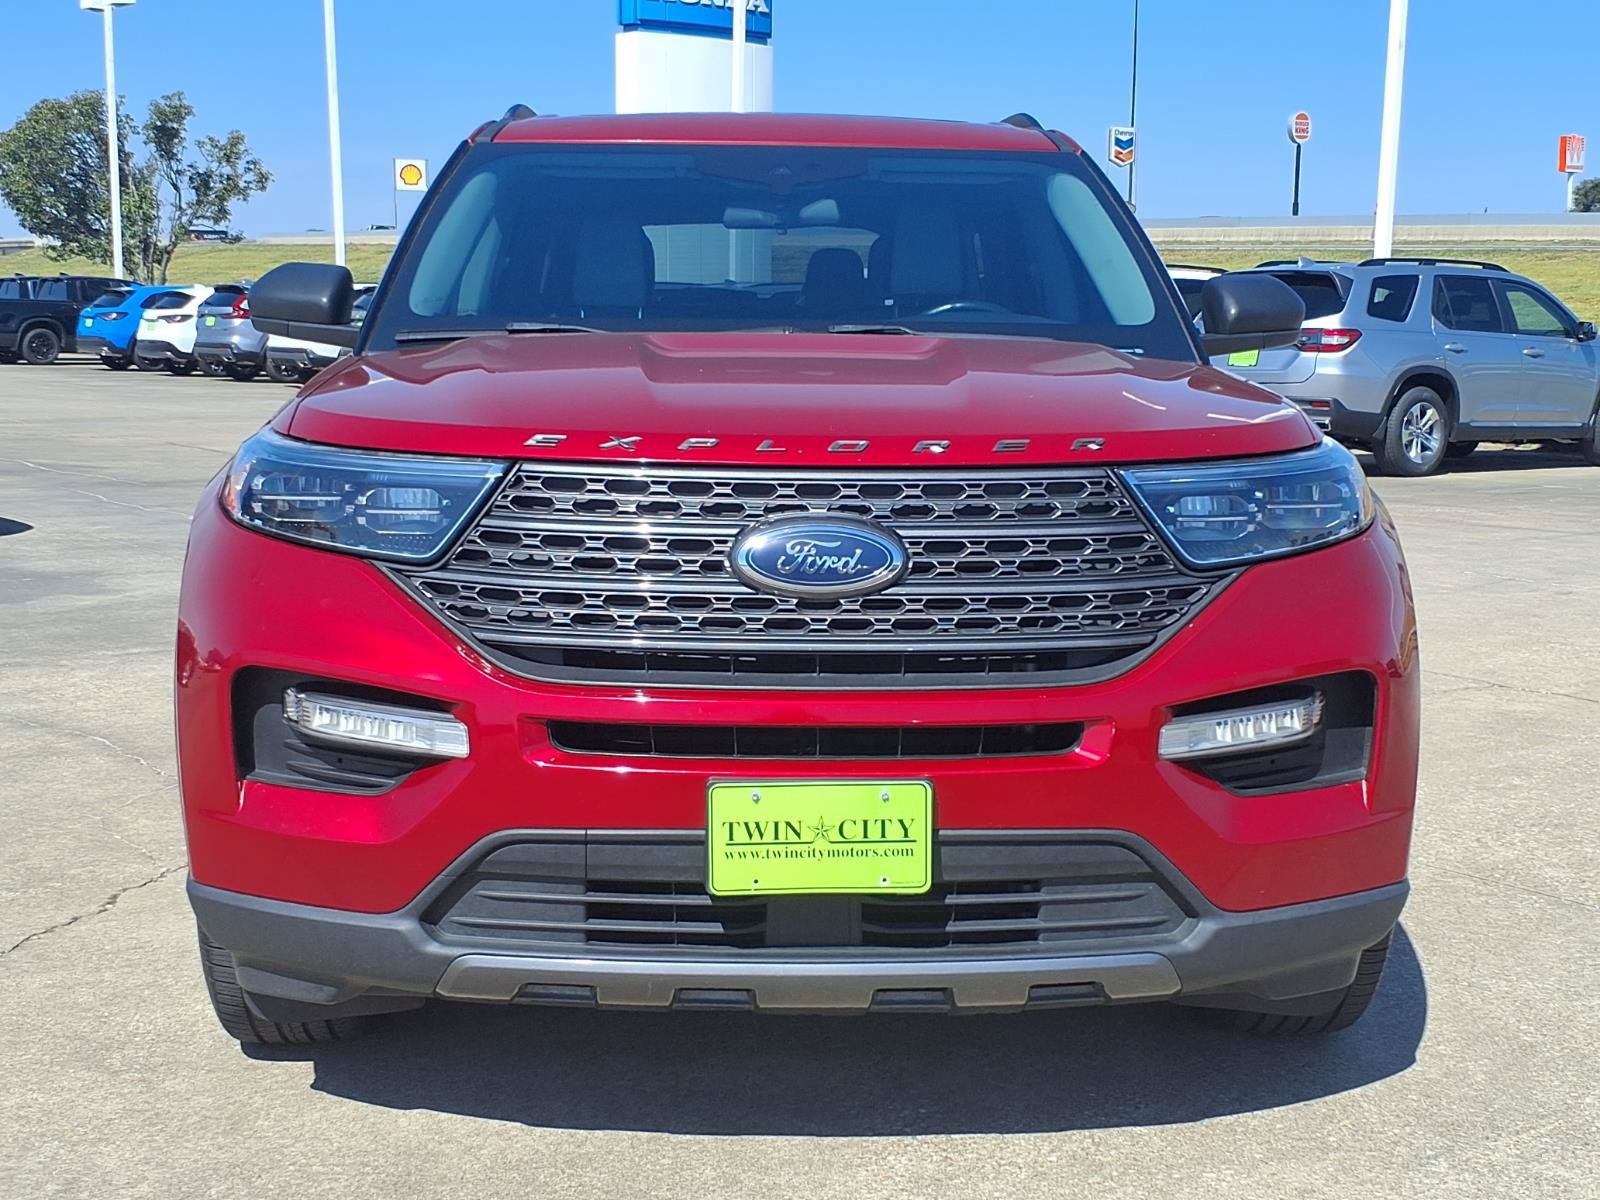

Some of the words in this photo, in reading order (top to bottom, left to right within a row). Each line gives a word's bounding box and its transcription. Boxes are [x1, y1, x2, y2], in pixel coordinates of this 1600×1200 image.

[523, 433, 1106, 453] EXPLORER
[776, 539, 869, 574] Ford
[722, 820, 803, 842] TWIN
[838, 818, 916, 840] CITY
[725, 846, 915, 862] www.twincitymotors.com
